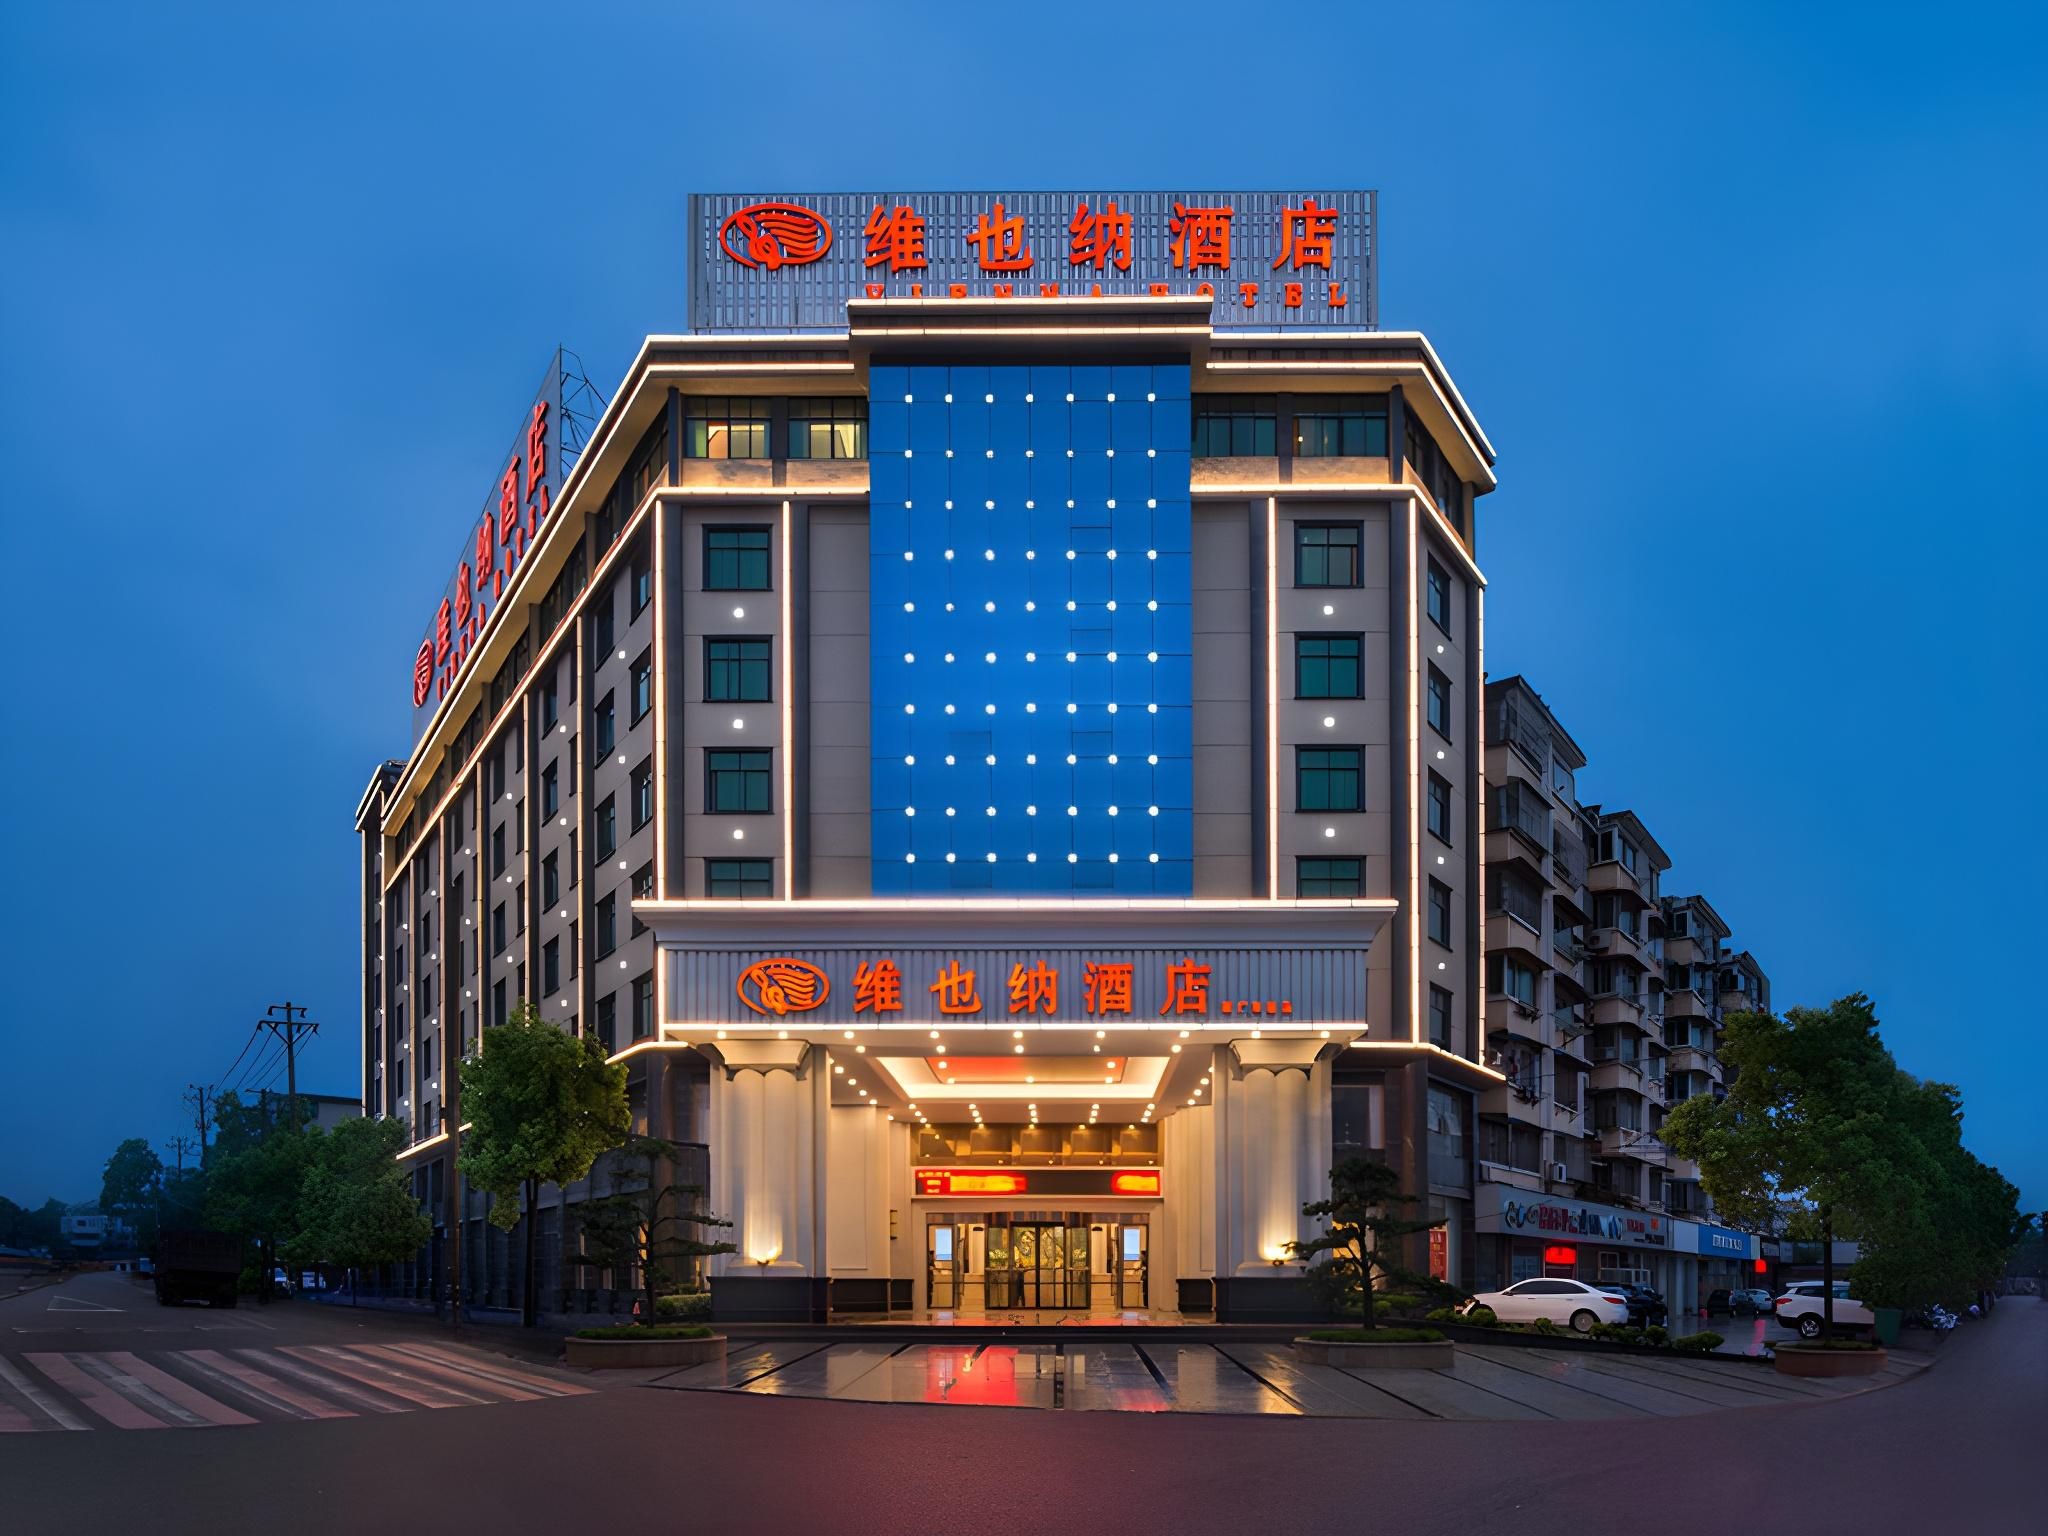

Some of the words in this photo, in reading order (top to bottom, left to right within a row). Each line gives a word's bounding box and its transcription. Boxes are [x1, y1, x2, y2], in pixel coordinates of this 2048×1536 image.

[863, 200, 1340, 272] 维也纳酒店
[852, 958, 1213, 1016] 维也纳酒店
